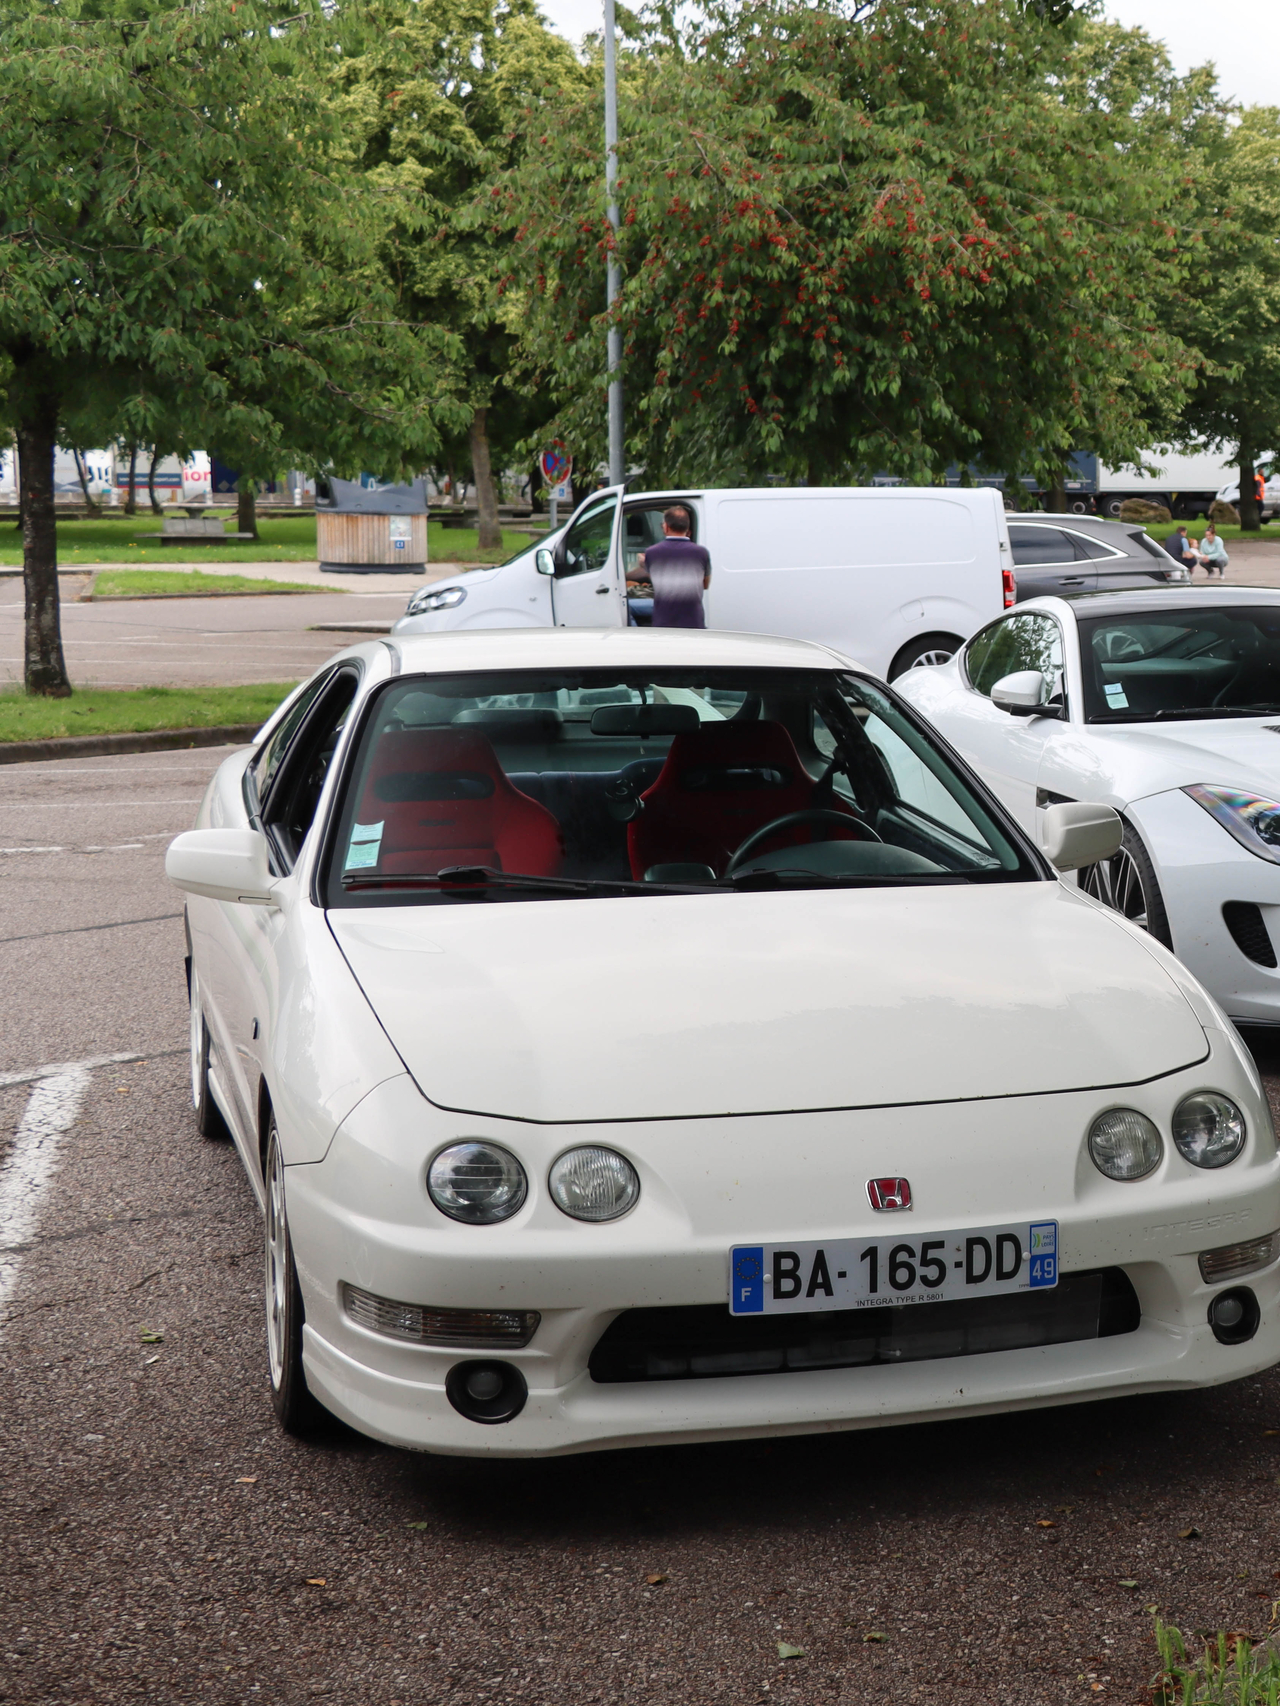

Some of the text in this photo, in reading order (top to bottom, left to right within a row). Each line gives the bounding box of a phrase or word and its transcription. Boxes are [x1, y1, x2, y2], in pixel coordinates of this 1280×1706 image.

[741, 1232, 1023, 1302] F BA-165-DD
[1032, 1258, 1055, 1280] 49
[856, 1293, 944, 1307] INTEGRA TYPE R 5801
